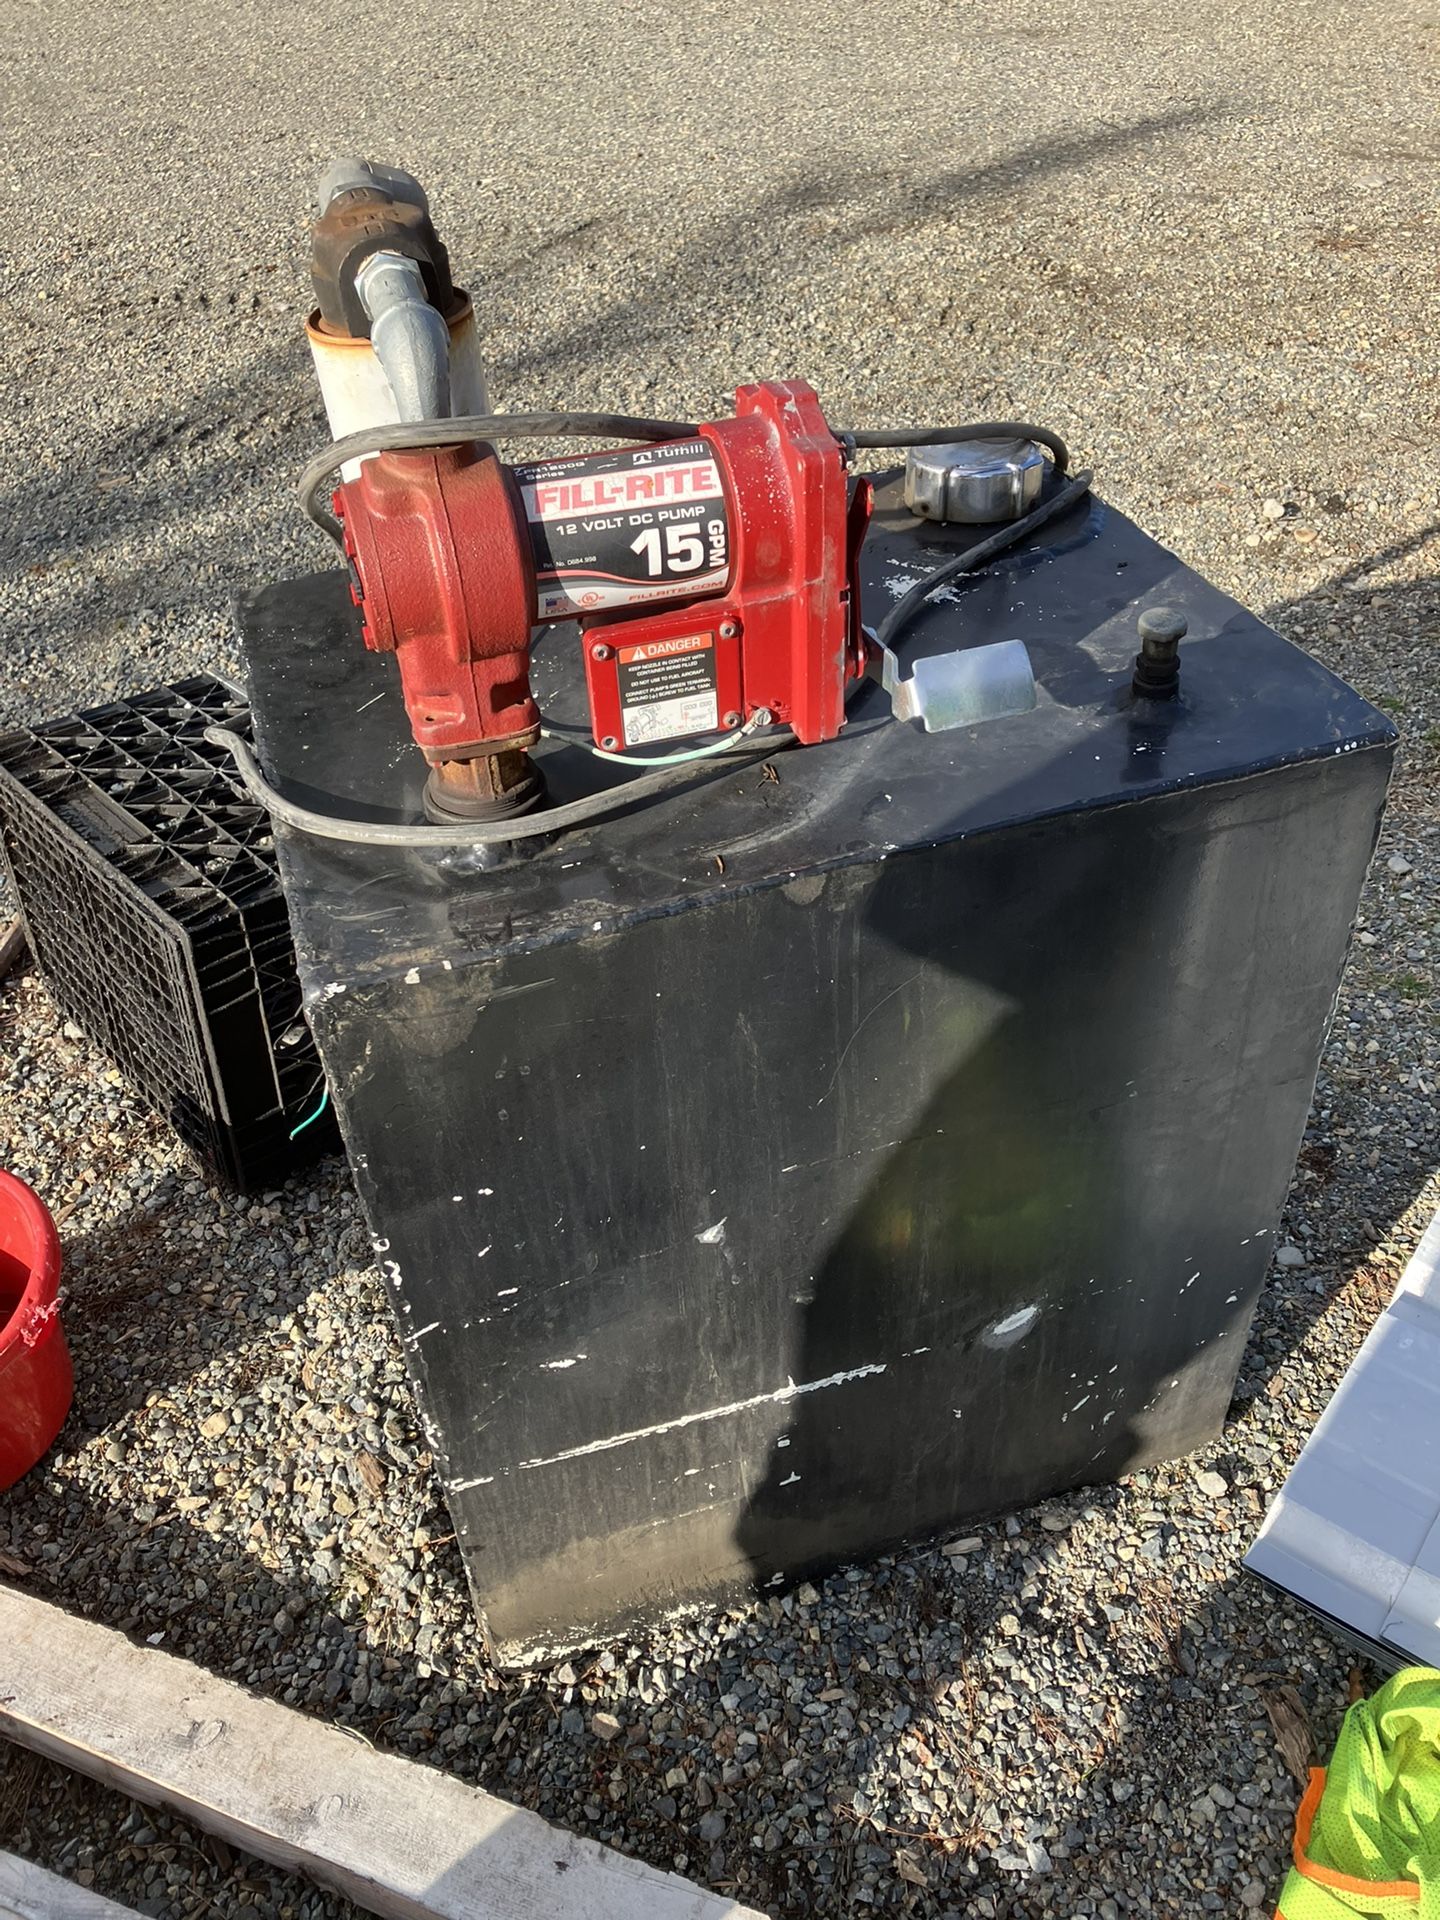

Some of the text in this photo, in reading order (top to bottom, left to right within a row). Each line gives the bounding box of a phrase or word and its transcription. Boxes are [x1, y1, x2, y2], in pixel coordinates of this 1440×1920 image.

[654, 443, 704, 459] Tuthill
[526, 471, 565, 480] Series
[535, 465, 713, 514] FILL-RITE
[556, 506, 706, 536] 12 VOLT DC PUMP
[630, 522, 704, 577] 15
[707, 519, 726, 567] GPM
[628, 580, 723, 601] FILLRITE.COM
[647, 637, 701, 656] DANGER
[636, 660, 698, 676] CONTAINER BEING FILLED
[642, 661, 661, 669] NOZZLE
[668, 656, 691, 665] CONTACT
[681, 668, 705, 678] AIRCRAFT
[625, 688, 649, 698] CONNECT
[686, 677, 712, 686] TERMINAL
[626, 694, 649, 703] GROUND
